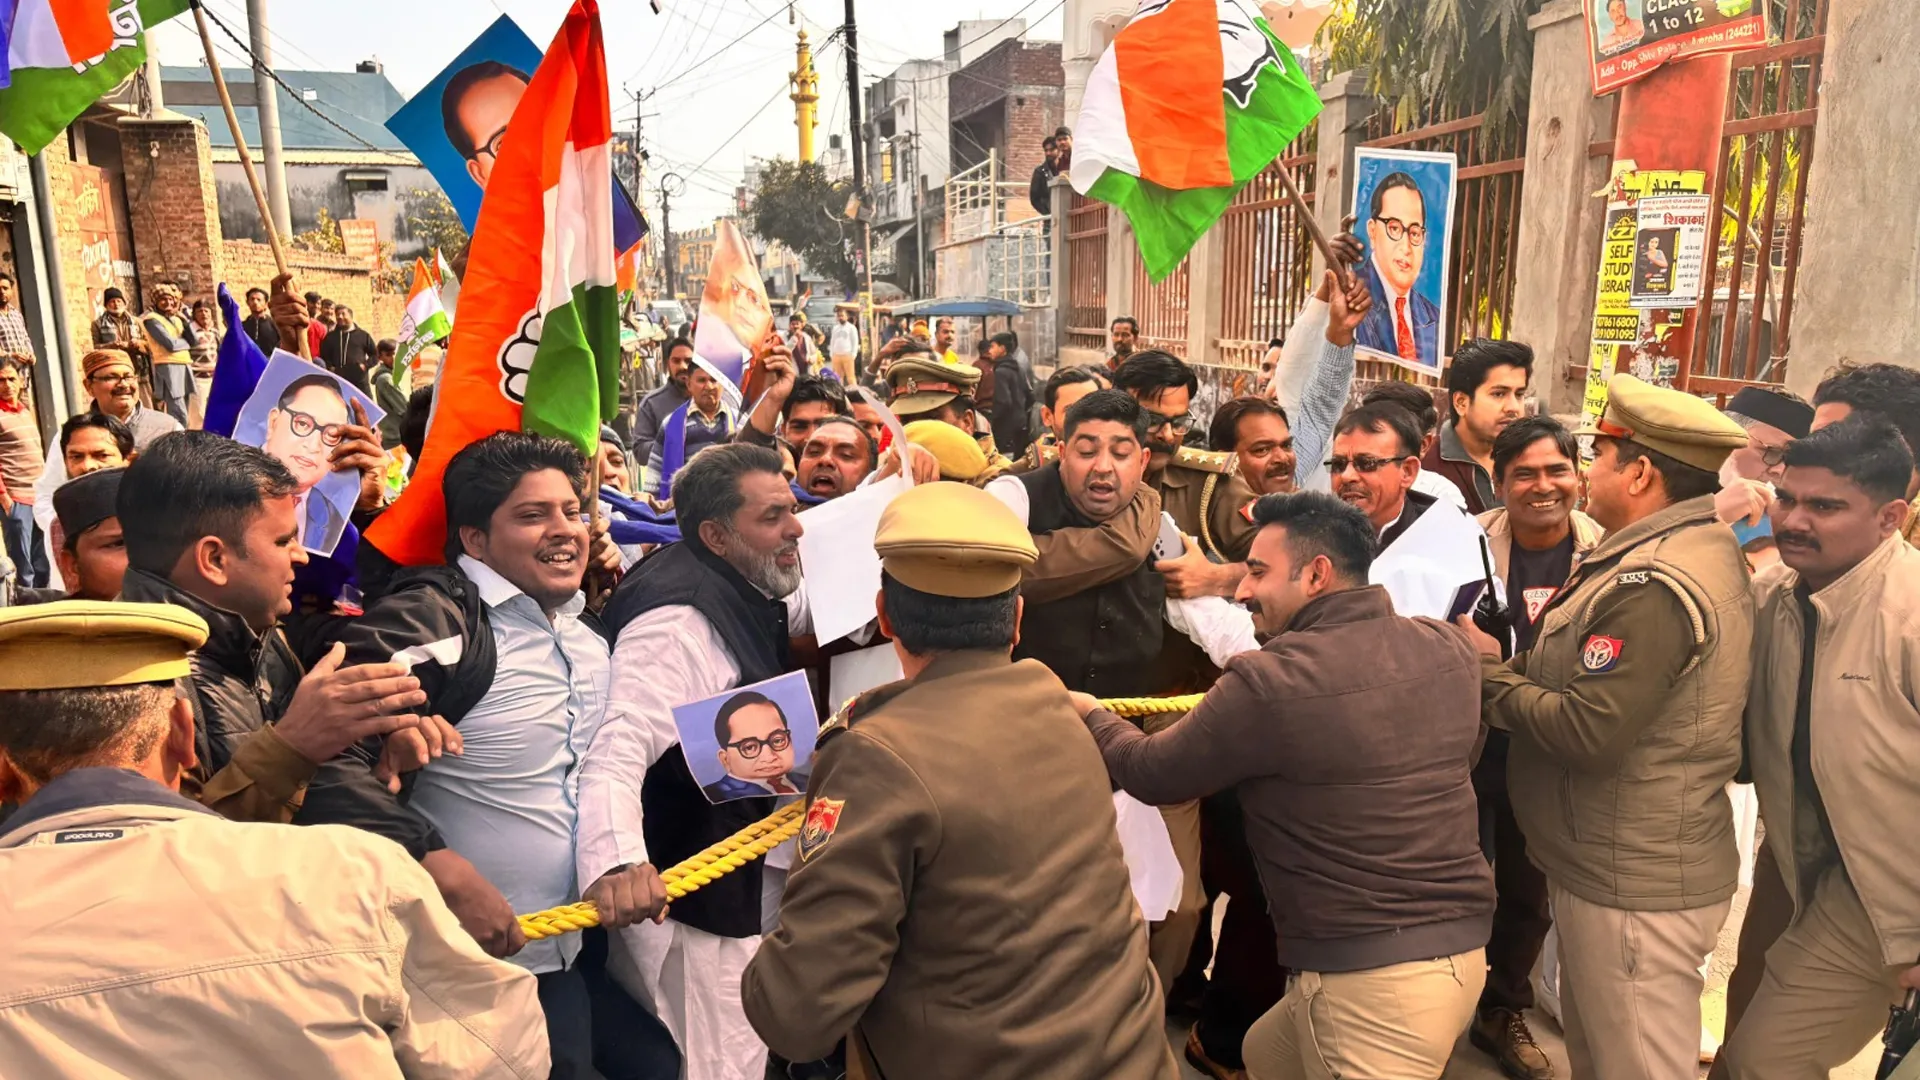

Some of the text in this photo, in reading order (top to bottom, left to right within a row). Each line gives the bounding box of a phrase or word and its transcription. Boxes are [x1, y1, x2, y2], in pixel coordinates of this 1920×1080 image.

[1646, 0, 1697, 14] CLA
[1649, 7, 1705, 34] 1 to 12
[1600, 66, 1616, 79] Add
[1609, 244, 1634, 259] SELF
[1600, 279, 1630, 293] LIBRAR
